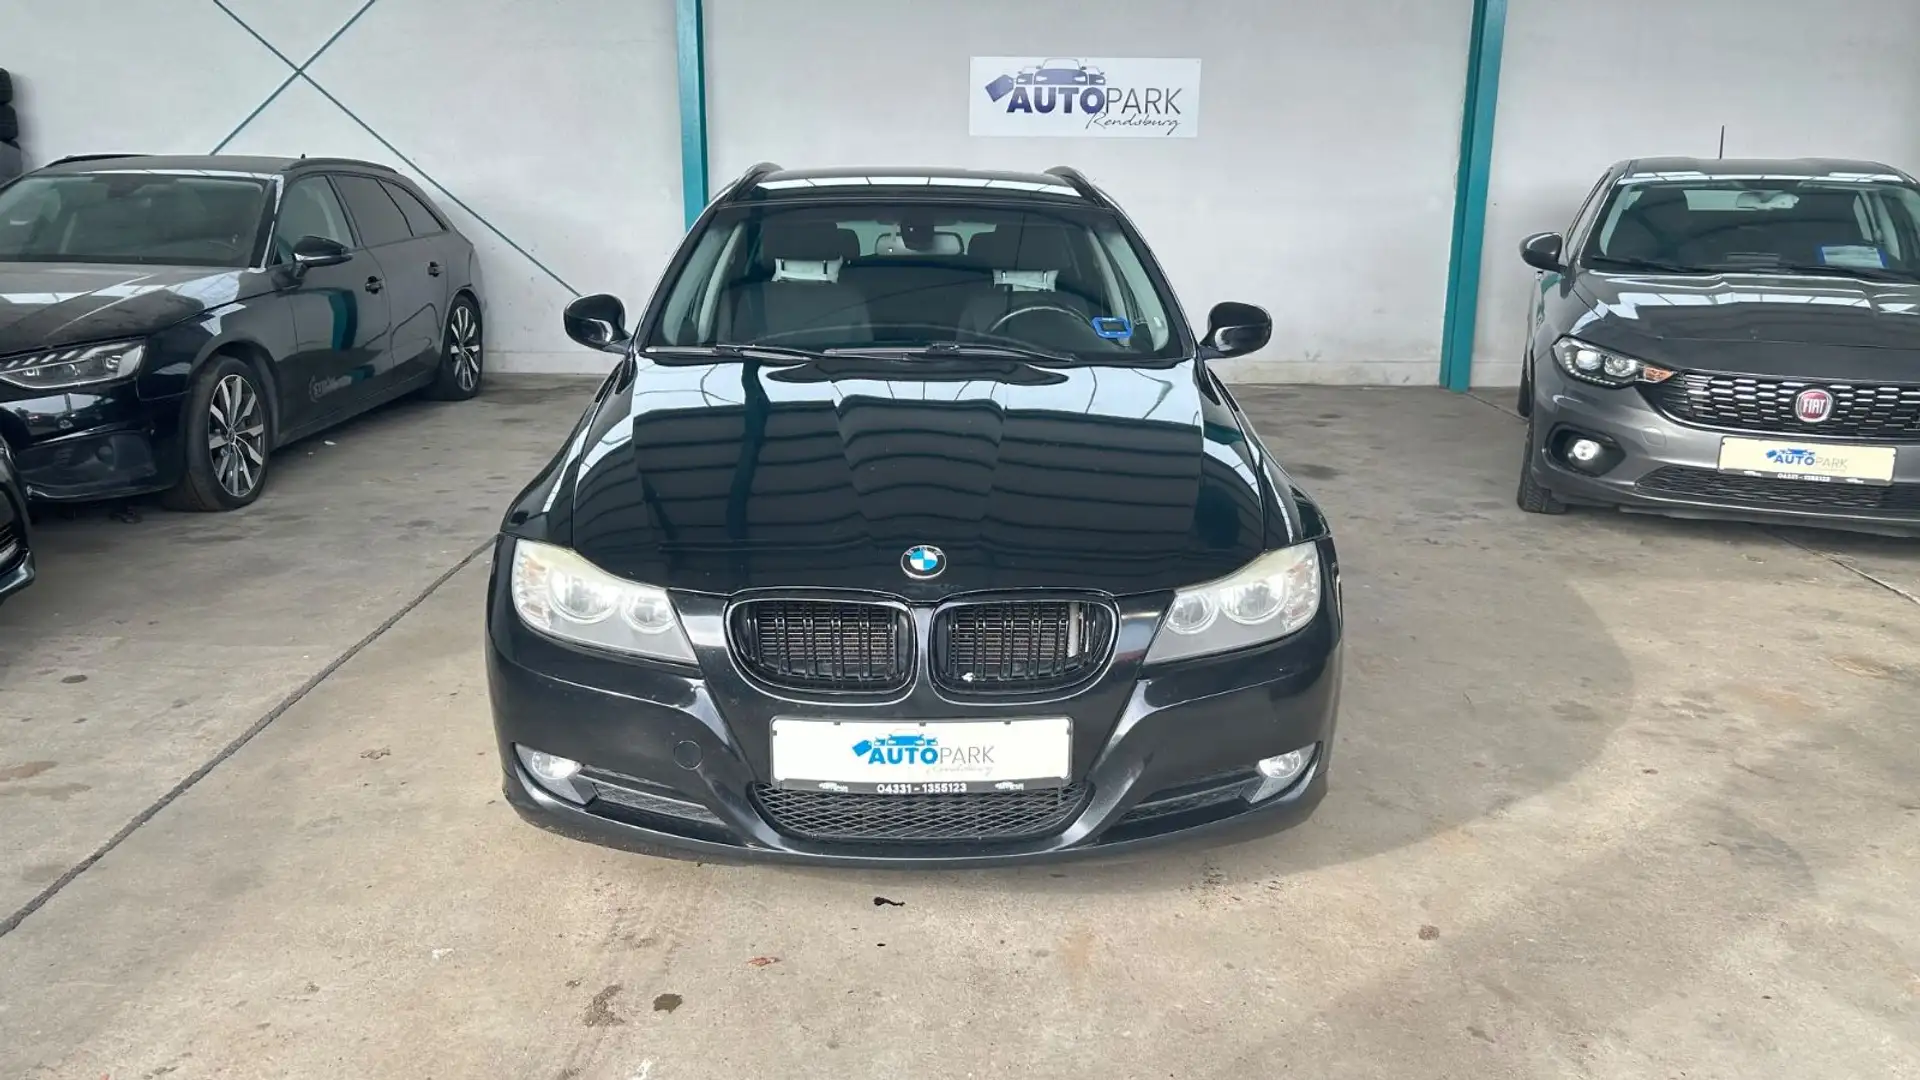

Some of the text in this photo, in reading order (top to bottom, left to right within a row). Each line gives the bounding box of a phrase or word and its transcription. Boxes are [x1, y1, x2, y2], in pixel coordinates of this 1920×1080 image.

[1006, 86, 1182, 115] AUTOPARK
[1085, 111, 1181, 135] Rendsburg
[1802, 398, 1826, 414] FIAT
[868, 746, 995, 765] AUTOPARK
[877, 783, 912, 794] 04331
[922, 782, 968, 793] 1355123
